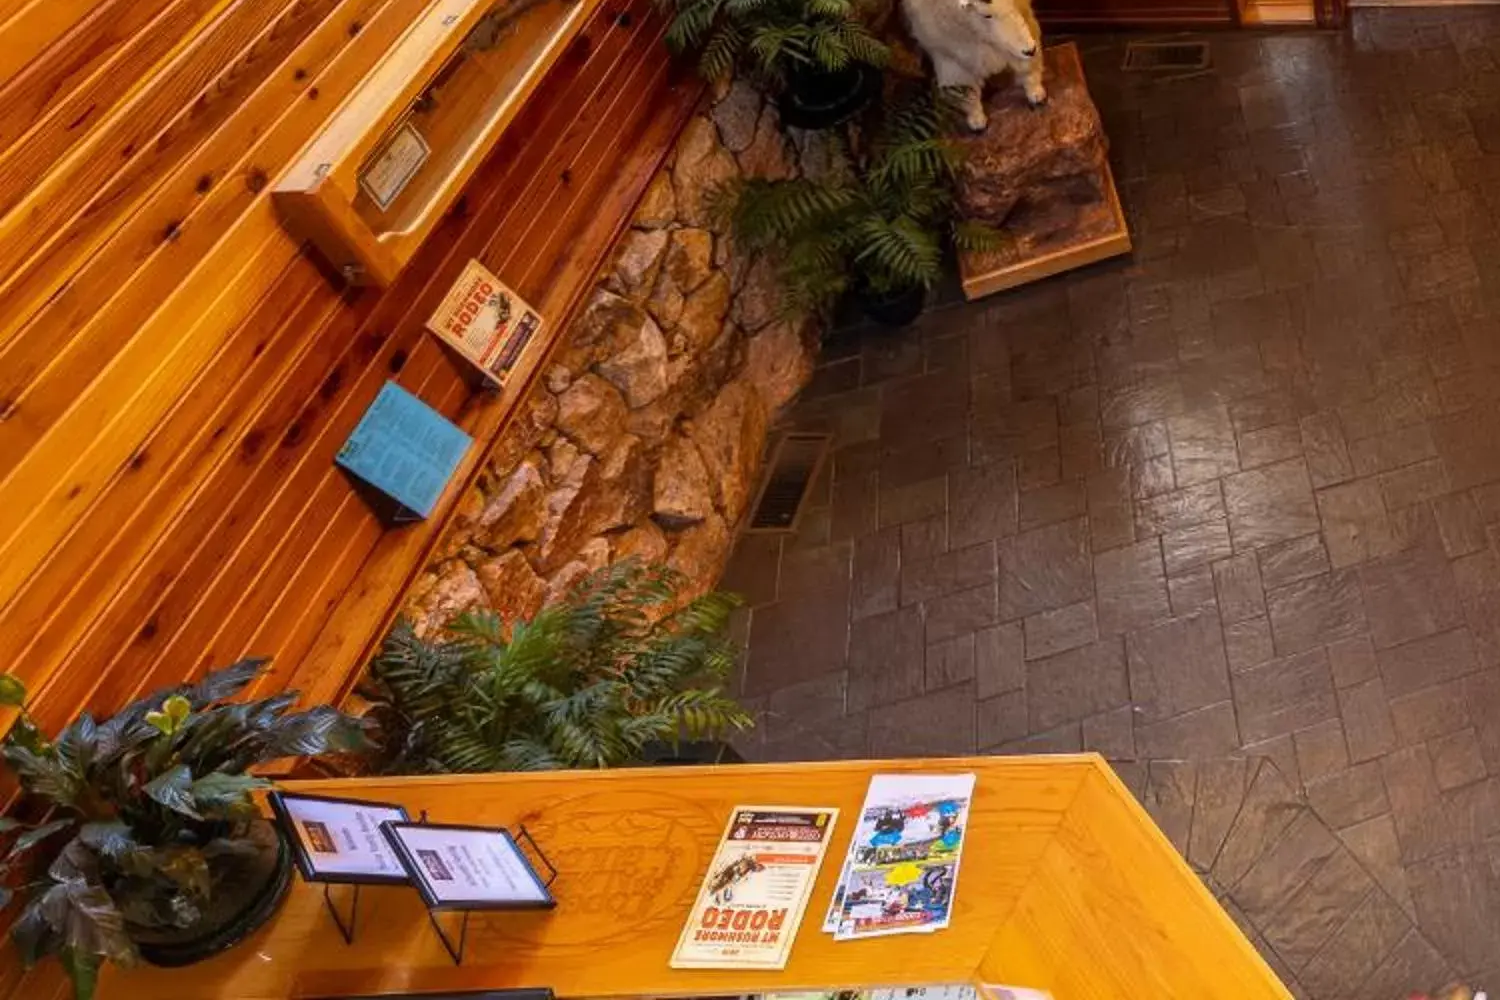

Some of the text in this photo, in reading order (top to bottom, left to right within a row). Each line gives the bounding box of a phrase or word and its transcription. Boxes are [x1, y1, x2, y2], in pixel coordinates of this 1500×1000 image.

[452, 283, 493, 338] RODEO
[702, 907, 788, 930] RODEO
[694, 931, 780, 944] MT RUSHMORE
